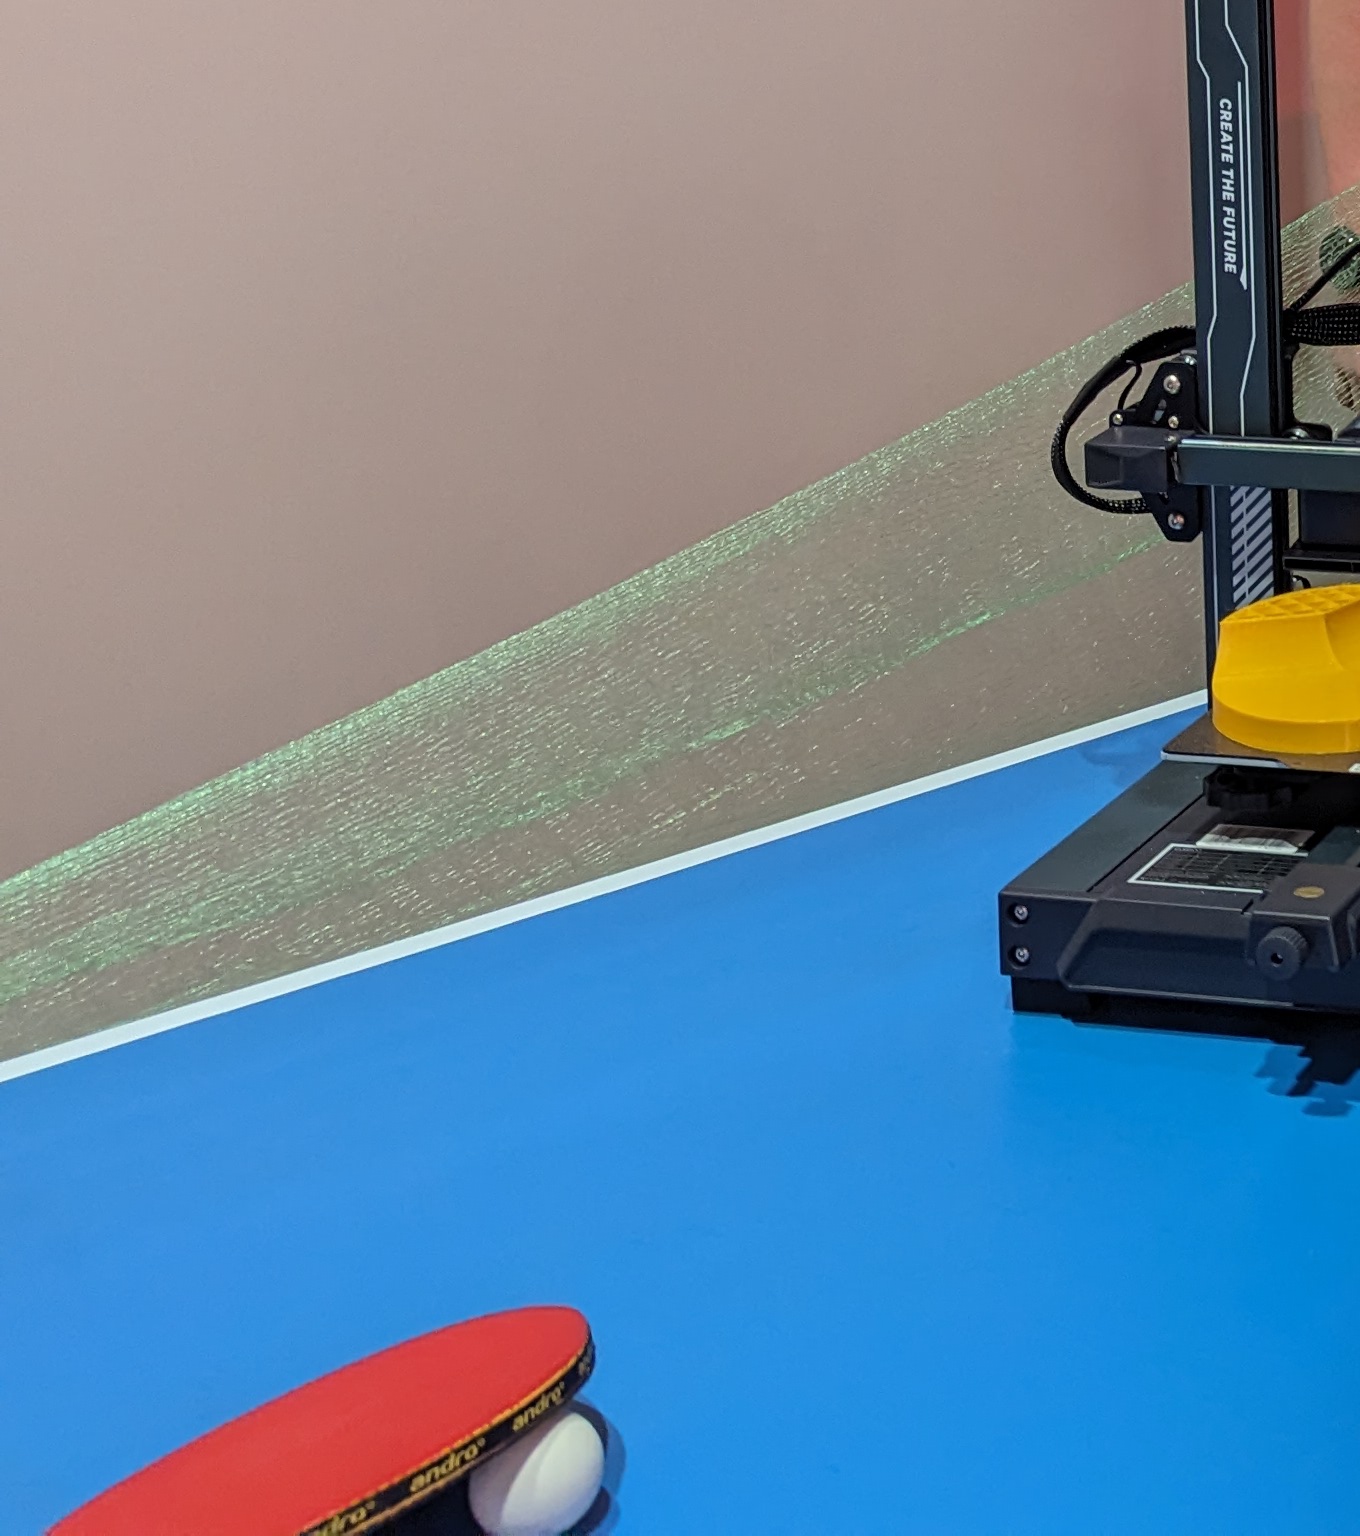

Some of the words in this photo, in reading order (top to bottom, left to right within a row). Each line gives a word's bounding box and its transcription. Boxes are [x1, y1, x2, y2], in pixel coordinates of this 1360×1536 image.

[1219, 98, 1234, 164] CREATE
[1222, 168, 1235, 202] THE
[1223, 206, 1237, 274] FUTURE
